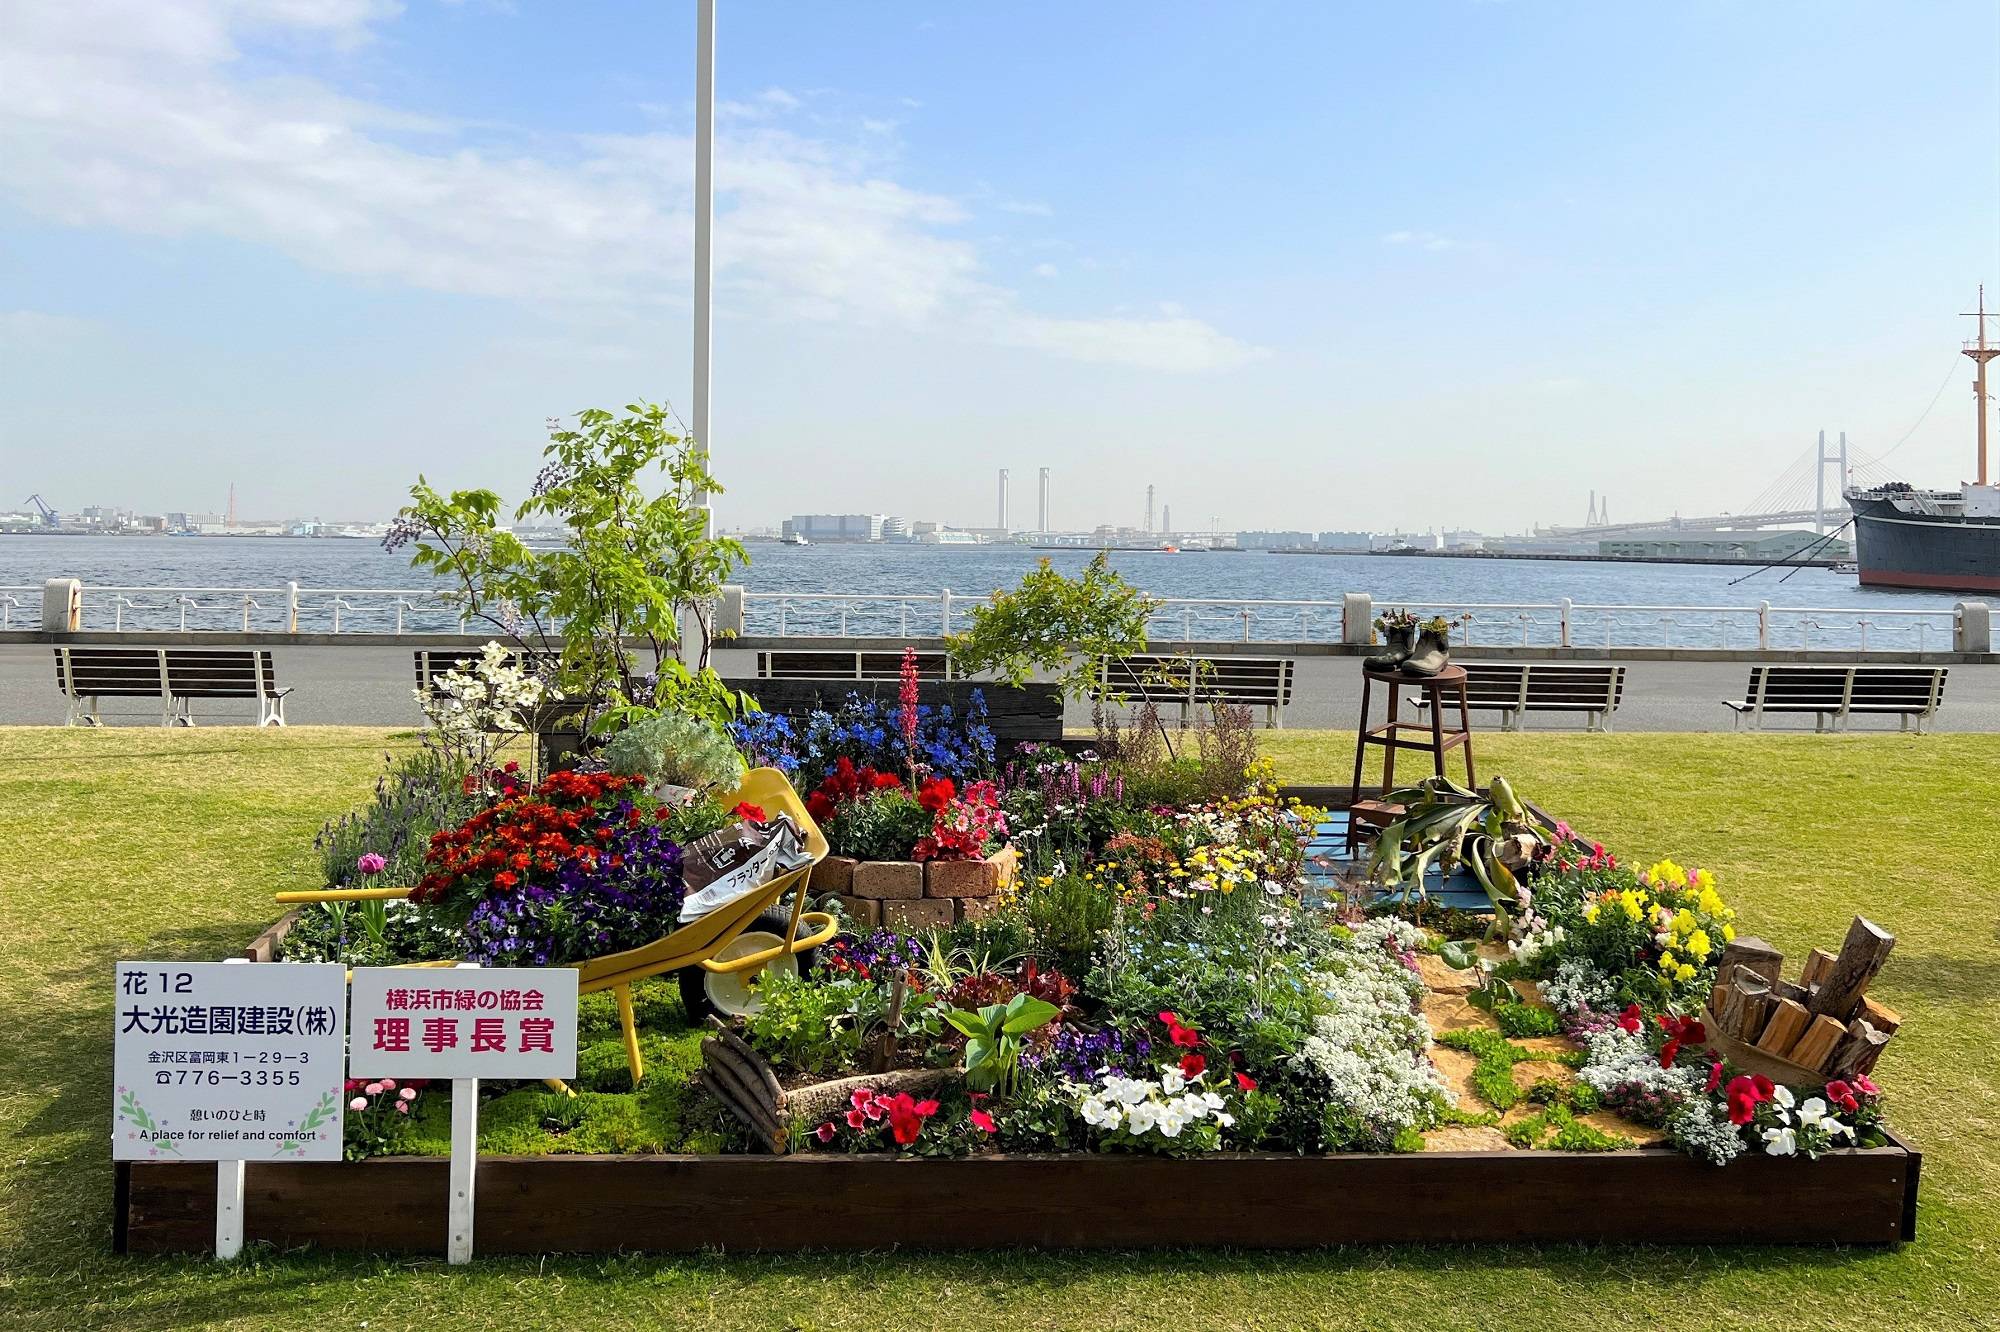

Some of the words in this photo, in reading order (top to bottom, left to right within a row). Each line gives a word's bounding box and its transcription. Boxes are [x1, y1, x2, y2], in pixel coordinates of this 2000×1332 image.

[386, 988, 545, 1011] 横浜市緑の協会
[122, 1004, 336, 1036] 大光造園建設(株)
[372, 1017, 555, 1054] 理事長賞
[189, 1108, 266, 1122] 憩いのひと時
[139, 1129, 149, 1140] A
[151, 1129, 185, 1144] place
[188, 1129, 205, 1140] for
[208, 1129, 240, 1140] relief
[242, 1129, 265, 1140] and
[268, 1129, 317, 1141] comfort
